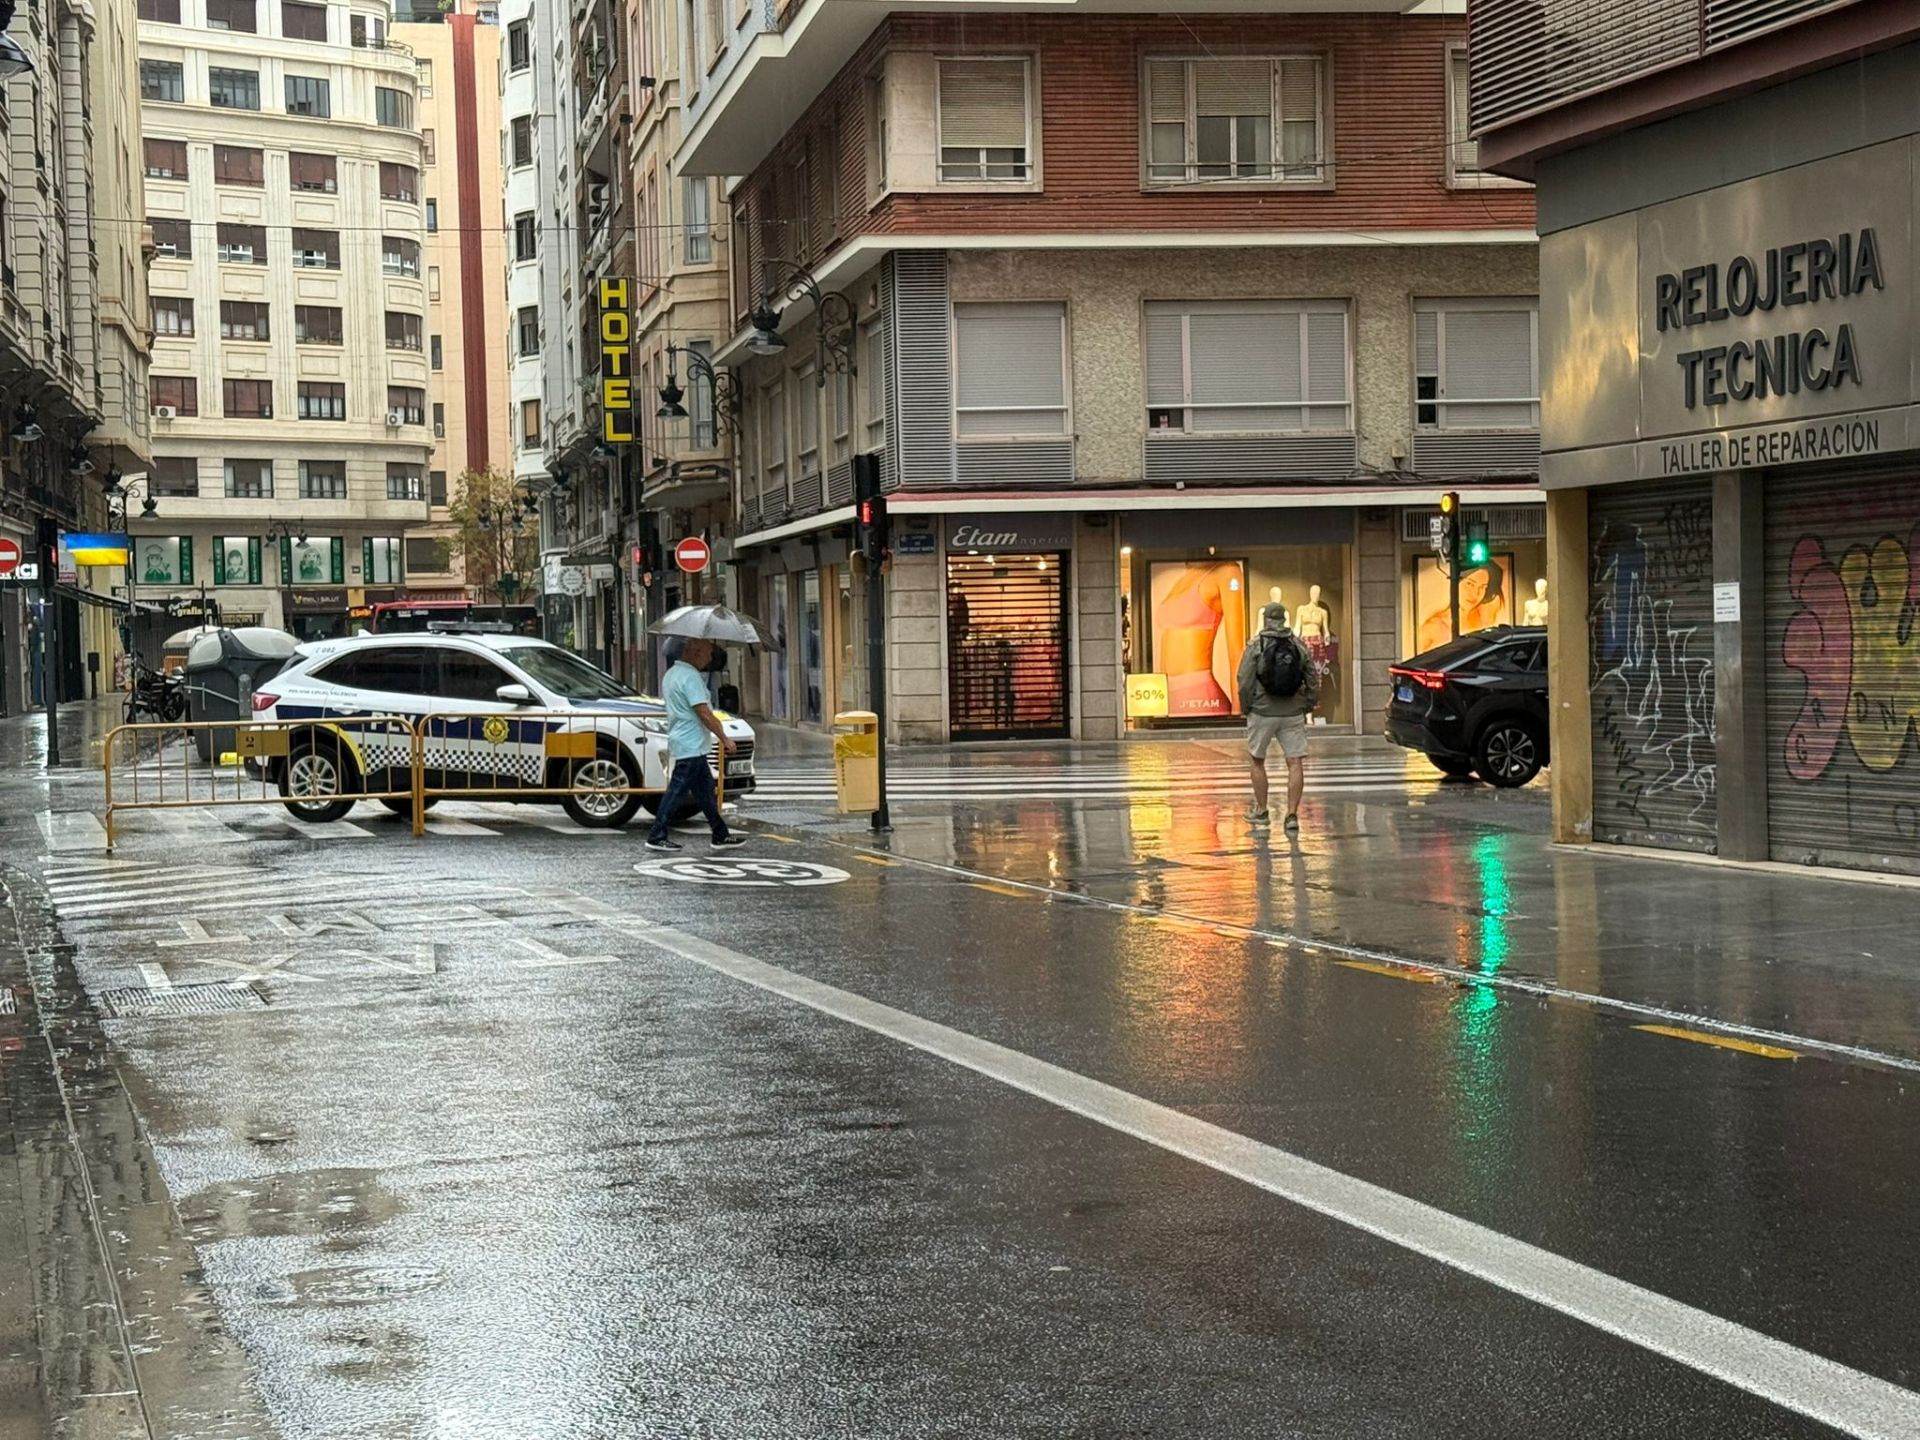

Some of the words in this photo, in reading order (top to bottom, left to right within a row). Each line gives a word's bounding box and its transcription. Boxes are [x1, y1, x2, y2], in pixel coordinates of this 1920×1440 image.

[1656, 228, 1884, 332] RELOJERIA
[600, 277, 633, 443] HOTEL
[1677, 323, 1861, 409] TECNICA
[1660, 439, 1723, 475] TALLER
[1729, 436, 1751, 467] DE
[1757, 415, 1879, 464] REPARACIÓN
[952, 525, 1018, 547] Etam
[1130, 690, 1165, 700] -50%
[672, 863, 813, 879] 30
[138, 937, 621, 995] TAXI
